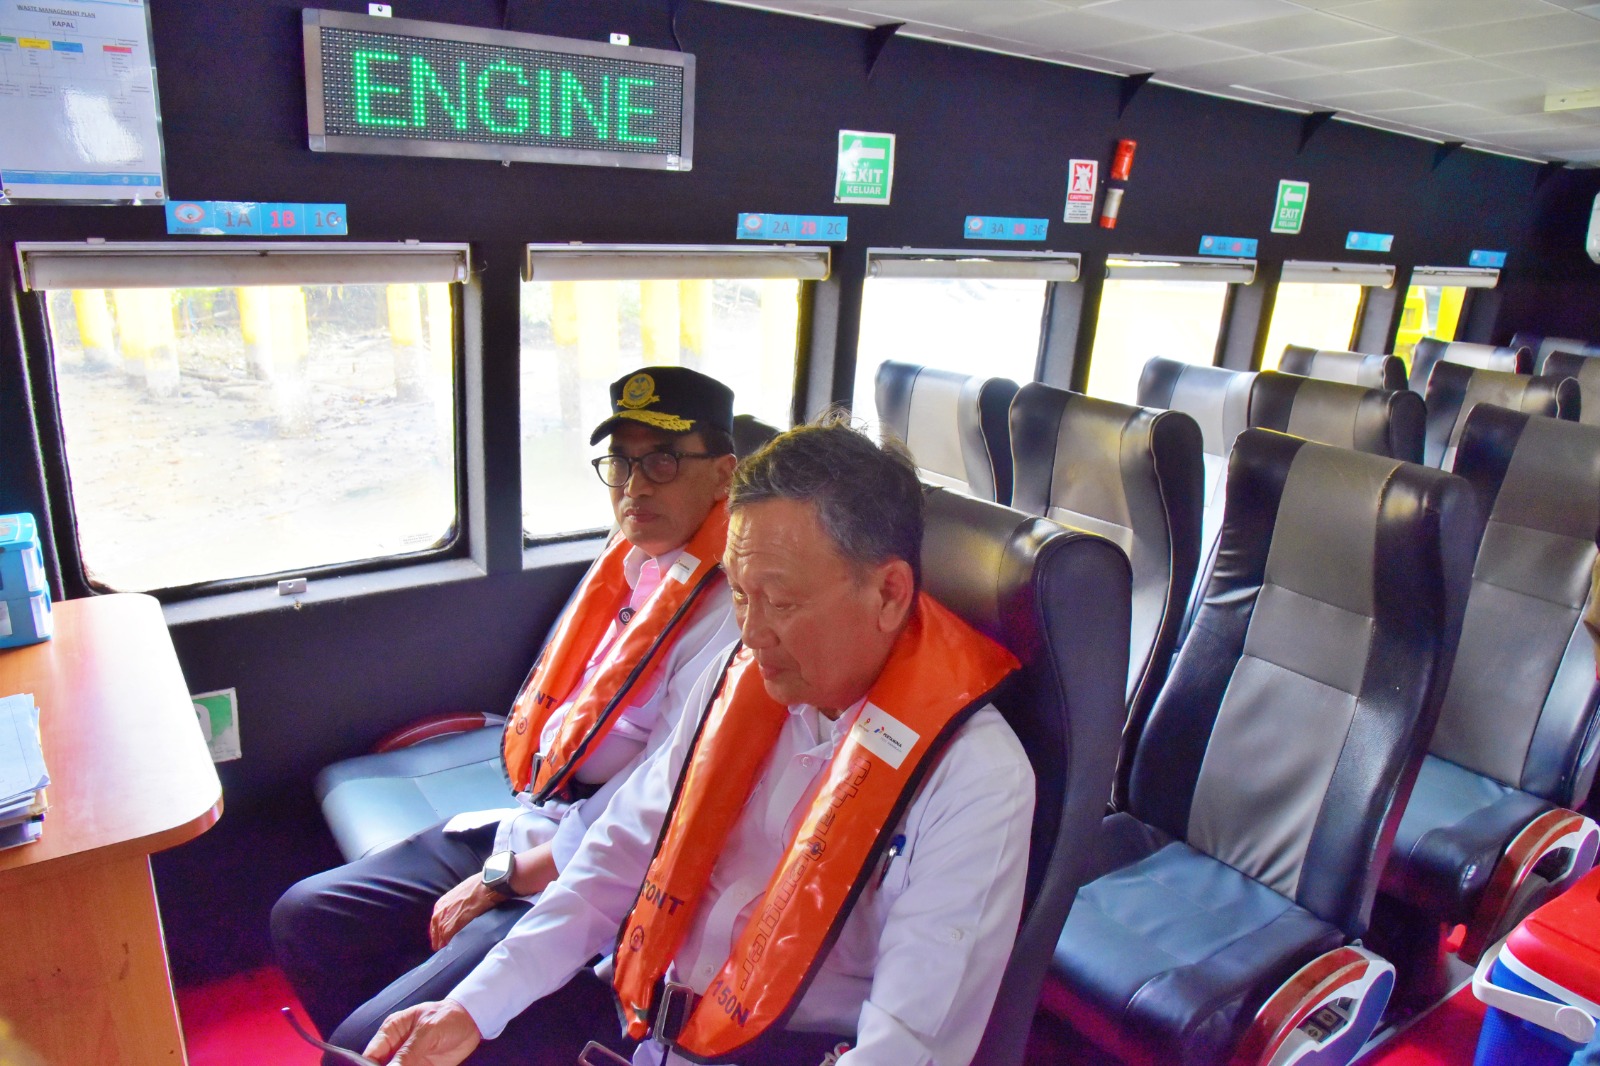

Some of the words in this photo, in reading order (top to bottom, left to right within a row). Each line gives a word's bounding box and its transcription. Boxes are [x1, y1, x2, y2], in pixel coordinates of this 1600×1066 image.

[17, 4, 38, 12] WASTE
[39, 7, 80, 16] MANAGEMENT
[52, 20, 75, 29] KAPAL
[355, 50, 658, 143] ENGINE
[847, 168, 884, 183] EXIT
[846, 185, 882, 195] KELUAR
[225, 211, 252, 228] 1A
[270, 210, 296, 229] 1B
[315, 211, 338, 228] 1C
[1280, 208, 1300, 219] EXIT
[772, 221, 790, 234] 2A
[826, 222, 841, 235] 2C
[991, 222, 1004, 235] 3A
[641, 879, 685, 916] RONT
[712, 980, 750, 1028] 150N
